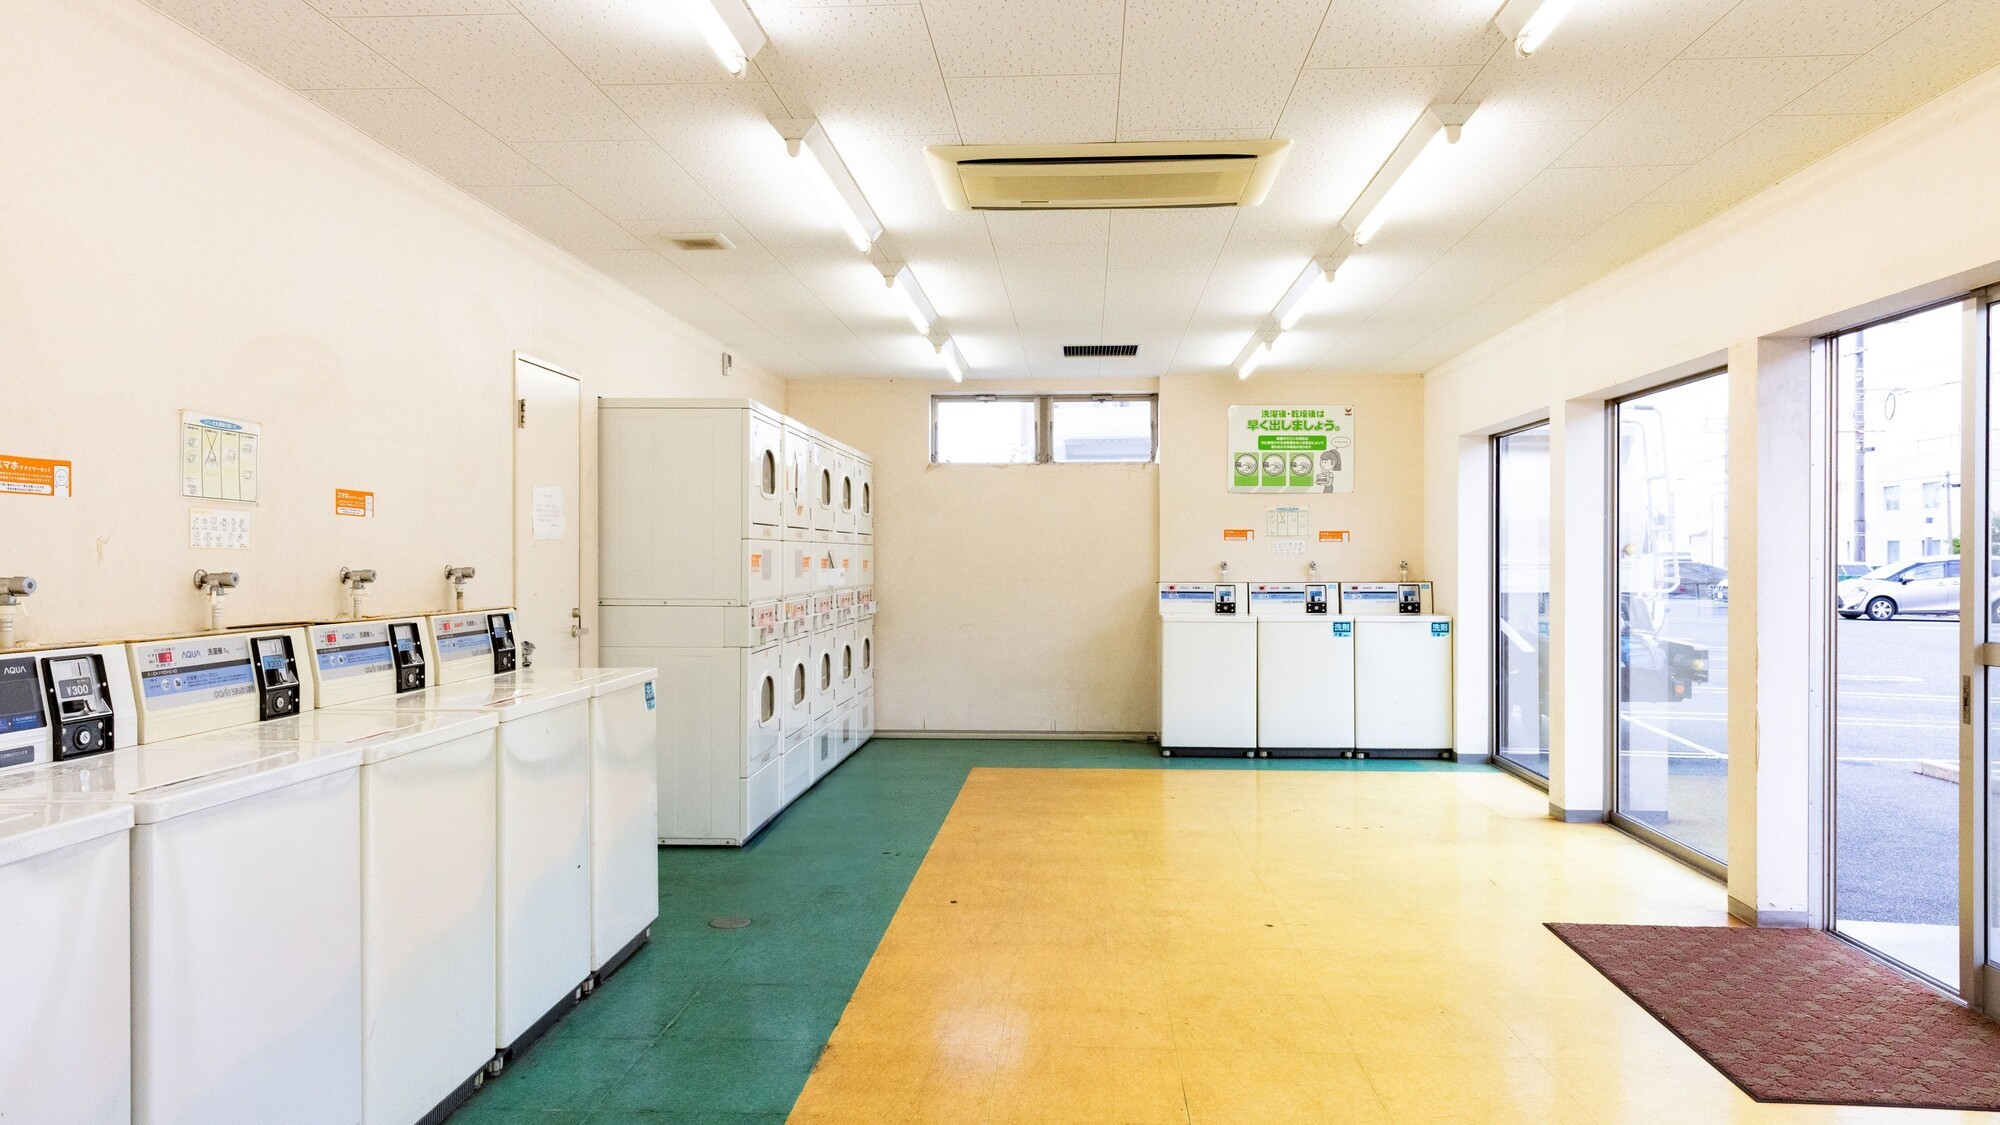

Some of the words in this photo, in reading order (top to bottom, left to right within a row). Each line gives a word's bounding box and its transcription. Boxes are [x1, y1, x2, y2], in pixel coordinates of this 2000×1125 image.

[1261, 409, 1325, 418] 洗濯後・乾燥後は
[1247, 419, 1340, 431] 早く出しましょう。
[1334, 623, 1350, 632] 洗剤
[1432, 623, 1448, 632] 洗剤
[181, 649, 201, 659] AQUA
[207, 647, 223, 656] 洗濯機
[266, 659, 282, 669] ¥300
[3, 665, 27, 675] AQUA
[66, 684, 89, 696] ¥300
